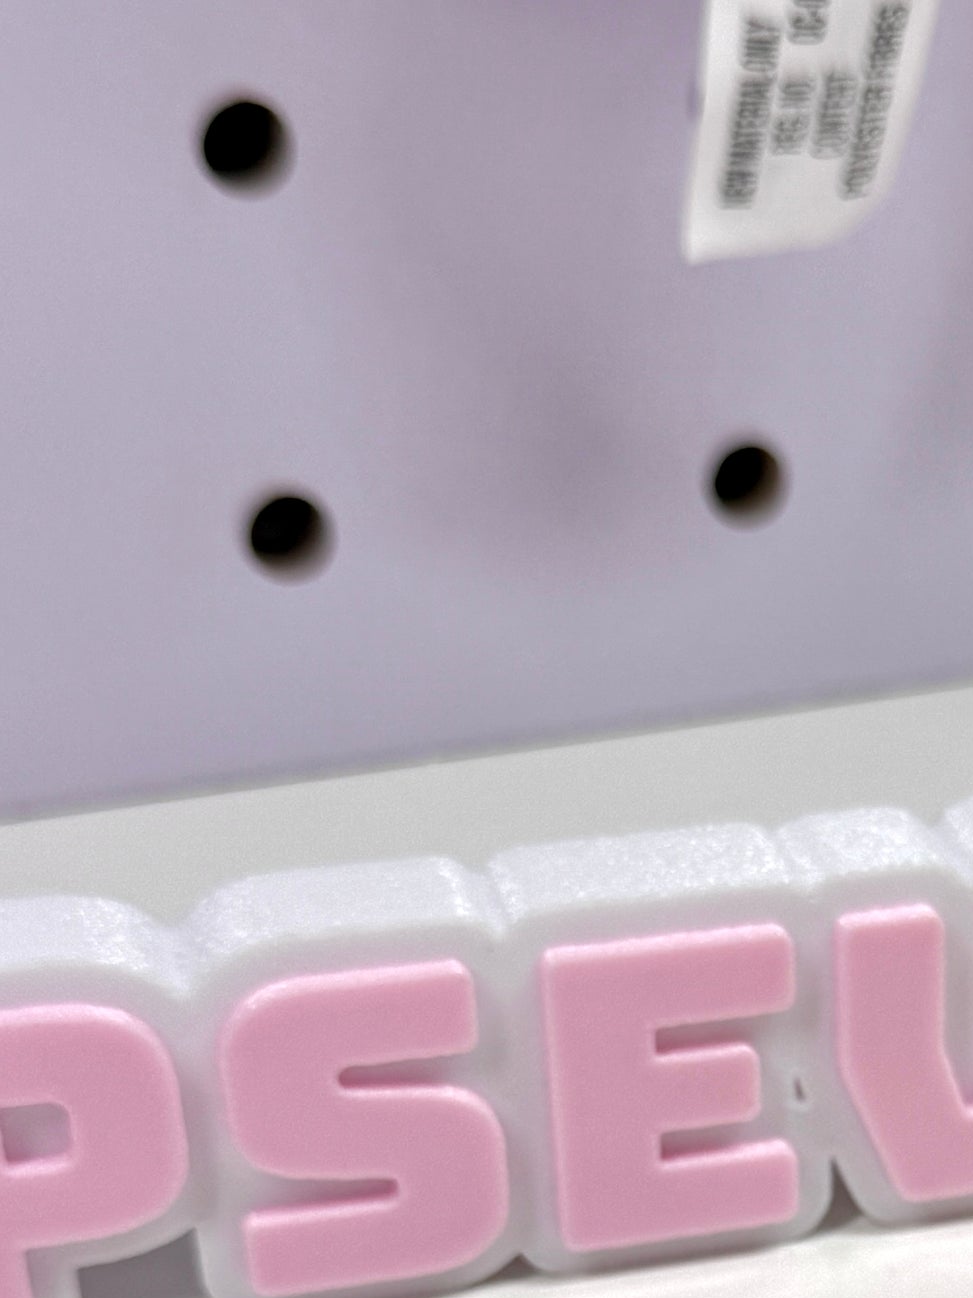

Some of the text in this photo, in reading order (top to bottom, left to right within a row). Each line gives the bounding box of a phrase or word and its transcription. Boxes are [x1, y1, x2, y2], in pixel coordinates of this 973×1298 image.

[742, 19, 781, 72] ONLY
[728, 75, 775, 169] MATERIAL
[840, 84, 892, 199] POLYESTER
